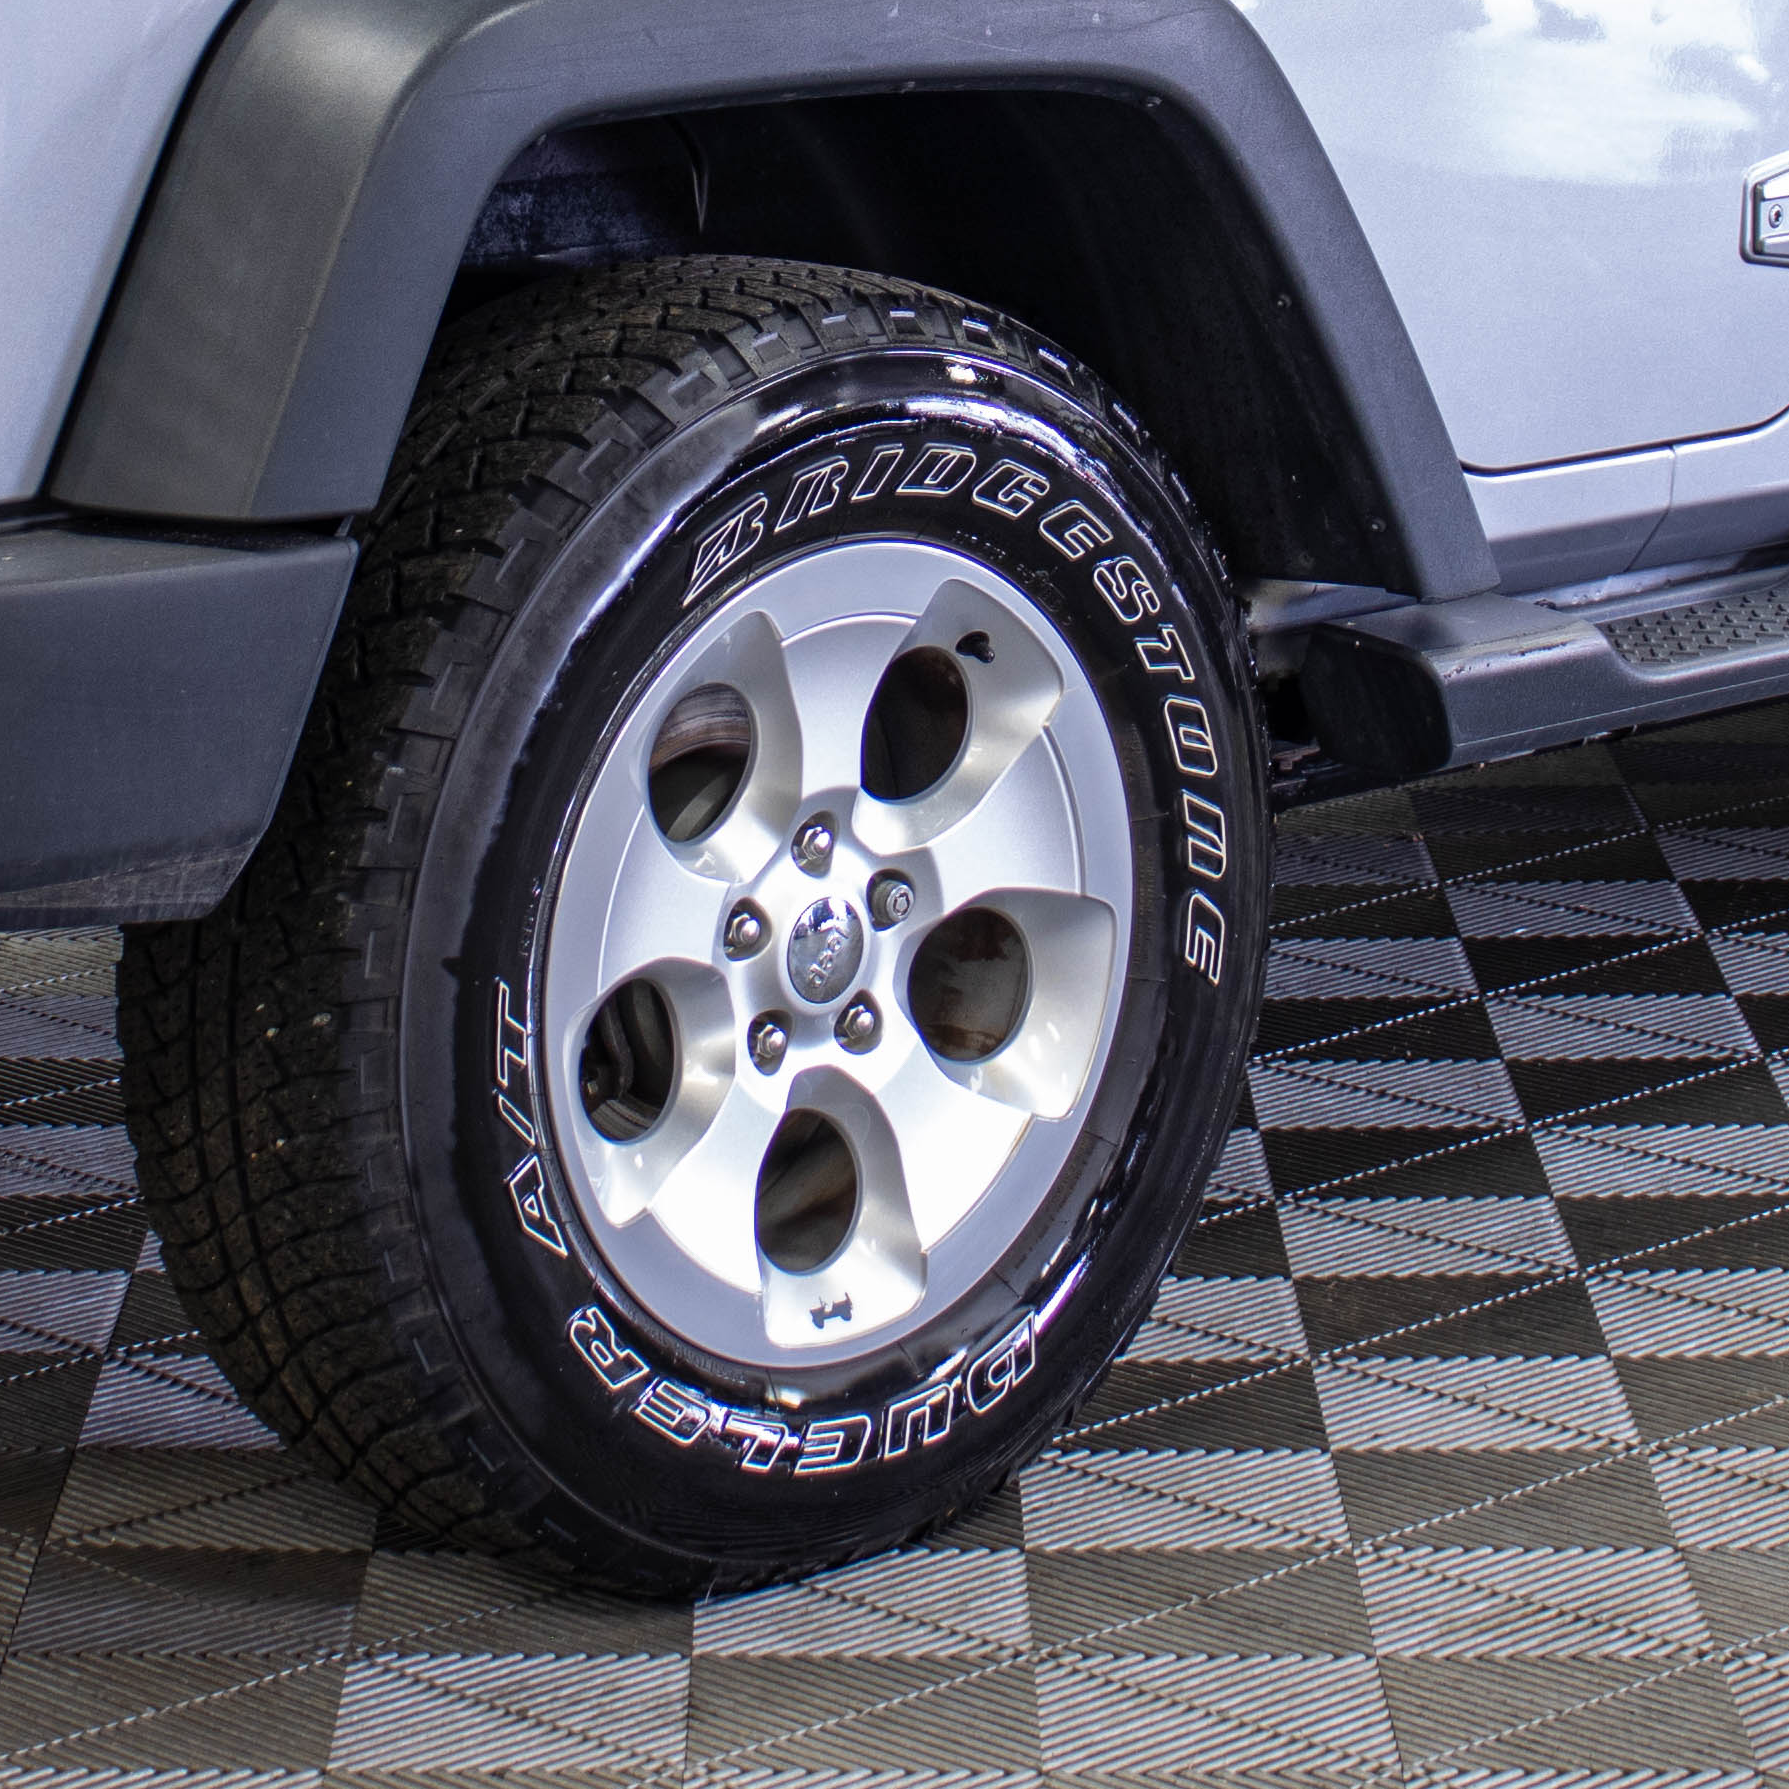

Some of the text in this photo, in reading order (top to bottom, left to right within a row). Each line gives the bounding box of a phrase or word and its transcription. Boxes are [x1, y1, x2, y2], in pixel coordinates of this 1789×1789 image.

[683, 442, 1226, 987] BRIDGESTONE
[490, 981, 1038, 1476] DUELER A/T
